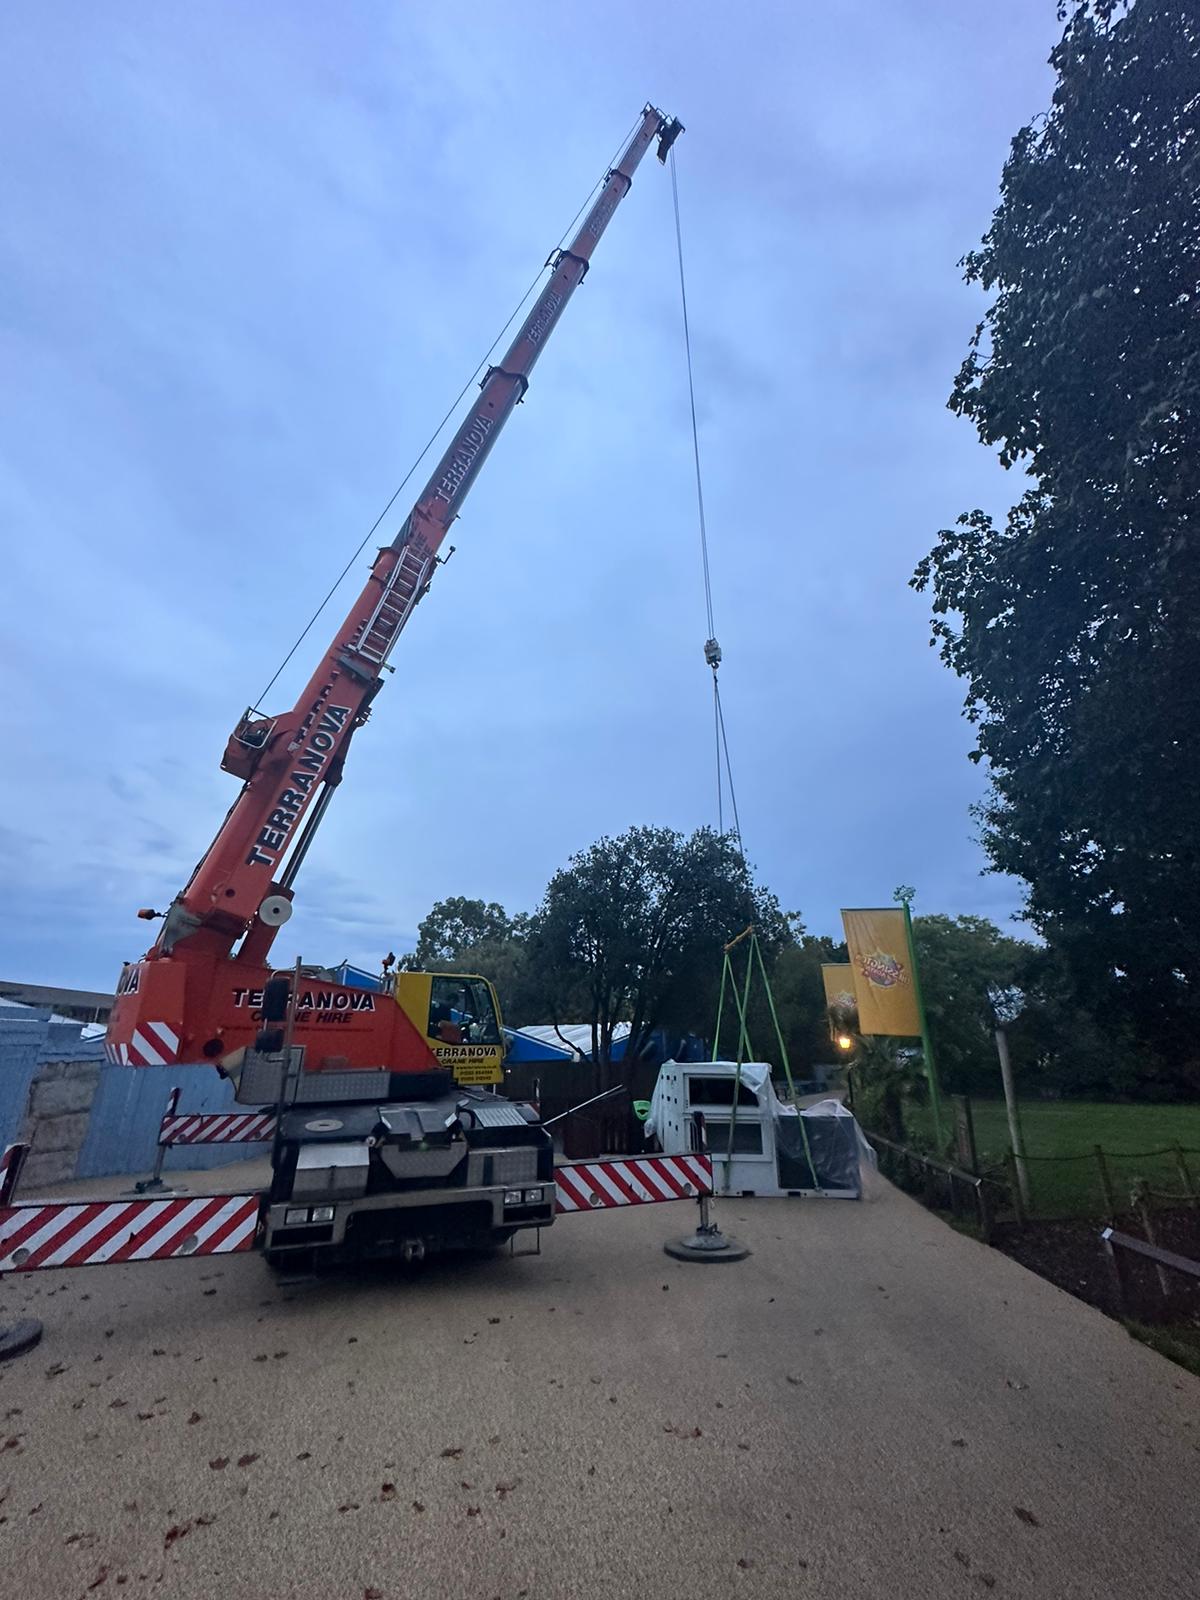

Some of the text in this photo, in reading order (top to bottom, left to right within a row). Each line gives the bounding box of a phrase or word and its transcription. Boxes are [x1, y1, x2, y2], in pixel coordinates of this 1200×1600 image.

[435, 414, 494, 504] TERRANOVA
[246, 704, 352, 866] TERRANOVA
[316, 1011, 353, 1023] HIRE
[432, 1047, 497, 1057] ERRANOVA
